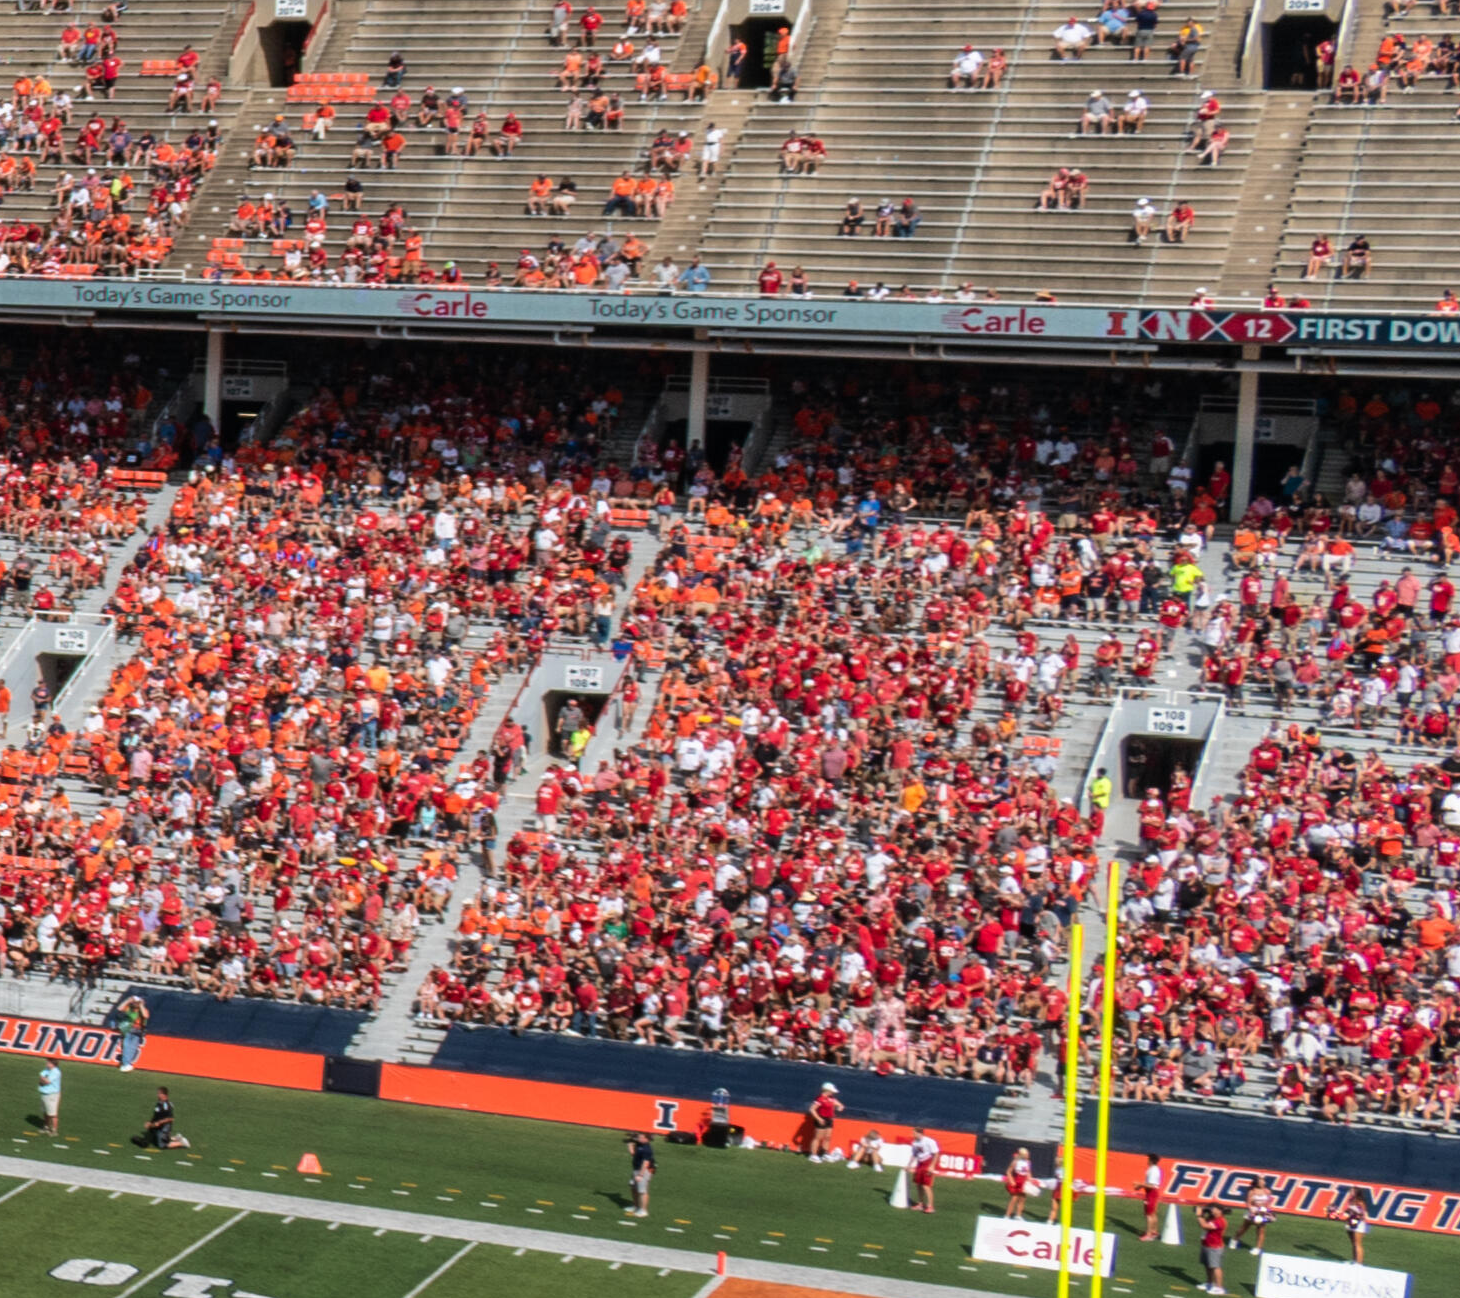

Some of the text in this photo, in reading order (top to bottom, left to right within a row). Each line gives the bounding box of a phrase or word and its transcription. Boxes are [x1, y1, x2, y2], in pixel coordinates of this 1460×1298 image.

[73, 285, 142, 306] Today's
[146, 287, 205, 306] Game
[209, 290, 291, 311] Sponsor
[414, 293, 489, 318] Carle
[589, 299, 667, 322] Today's
[672, 302, 739, 321] Game
[744, 303, 838, 324] Sponsor
[960, 307, 1046, 334] Carle
[1243, 318, 1272, 338] 12
[1299, 318, 1382, 341] FIRST
[654, 1100, 679, 1132] I
[1165, 1162, 1432, 1225] FIGHTING
[1004, 1229, 1105, 1266] Carle
